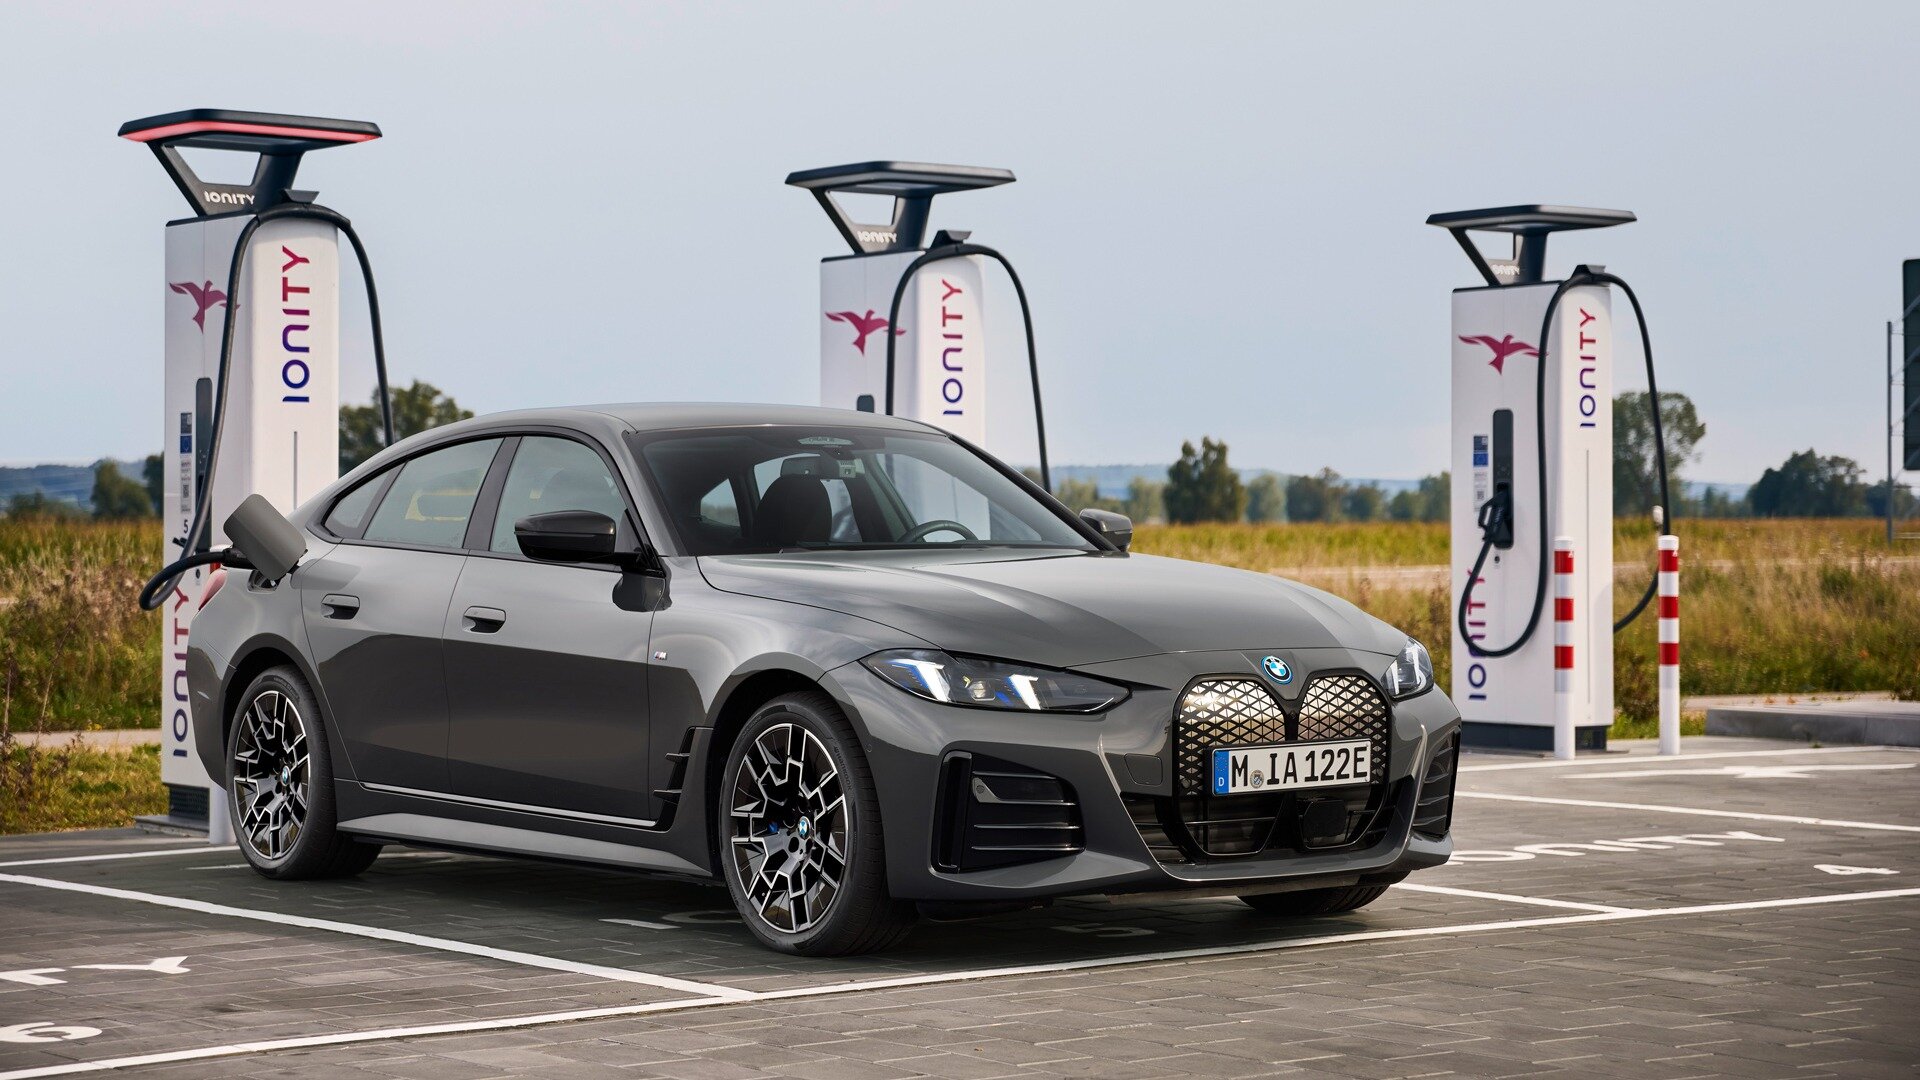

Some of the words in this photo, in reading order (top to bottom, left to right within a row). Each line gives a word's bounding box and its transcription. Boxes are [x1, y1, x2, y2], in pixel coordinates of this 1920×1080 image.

[204, 190, 255, 205] IONITY
[282, 245, 310, 402] IONITY
[942, 279, 963, 415] IONITY
[1579, 308, 1596, 428] IONITY
[1218, 777, 1225, 787] D
[1231, 754, 1248, 787] M
[1266, 752, 1298, 785] IA
[1305, 746, 1368, 782] 122E
[1447, 831, 1785, 866] ONITY
